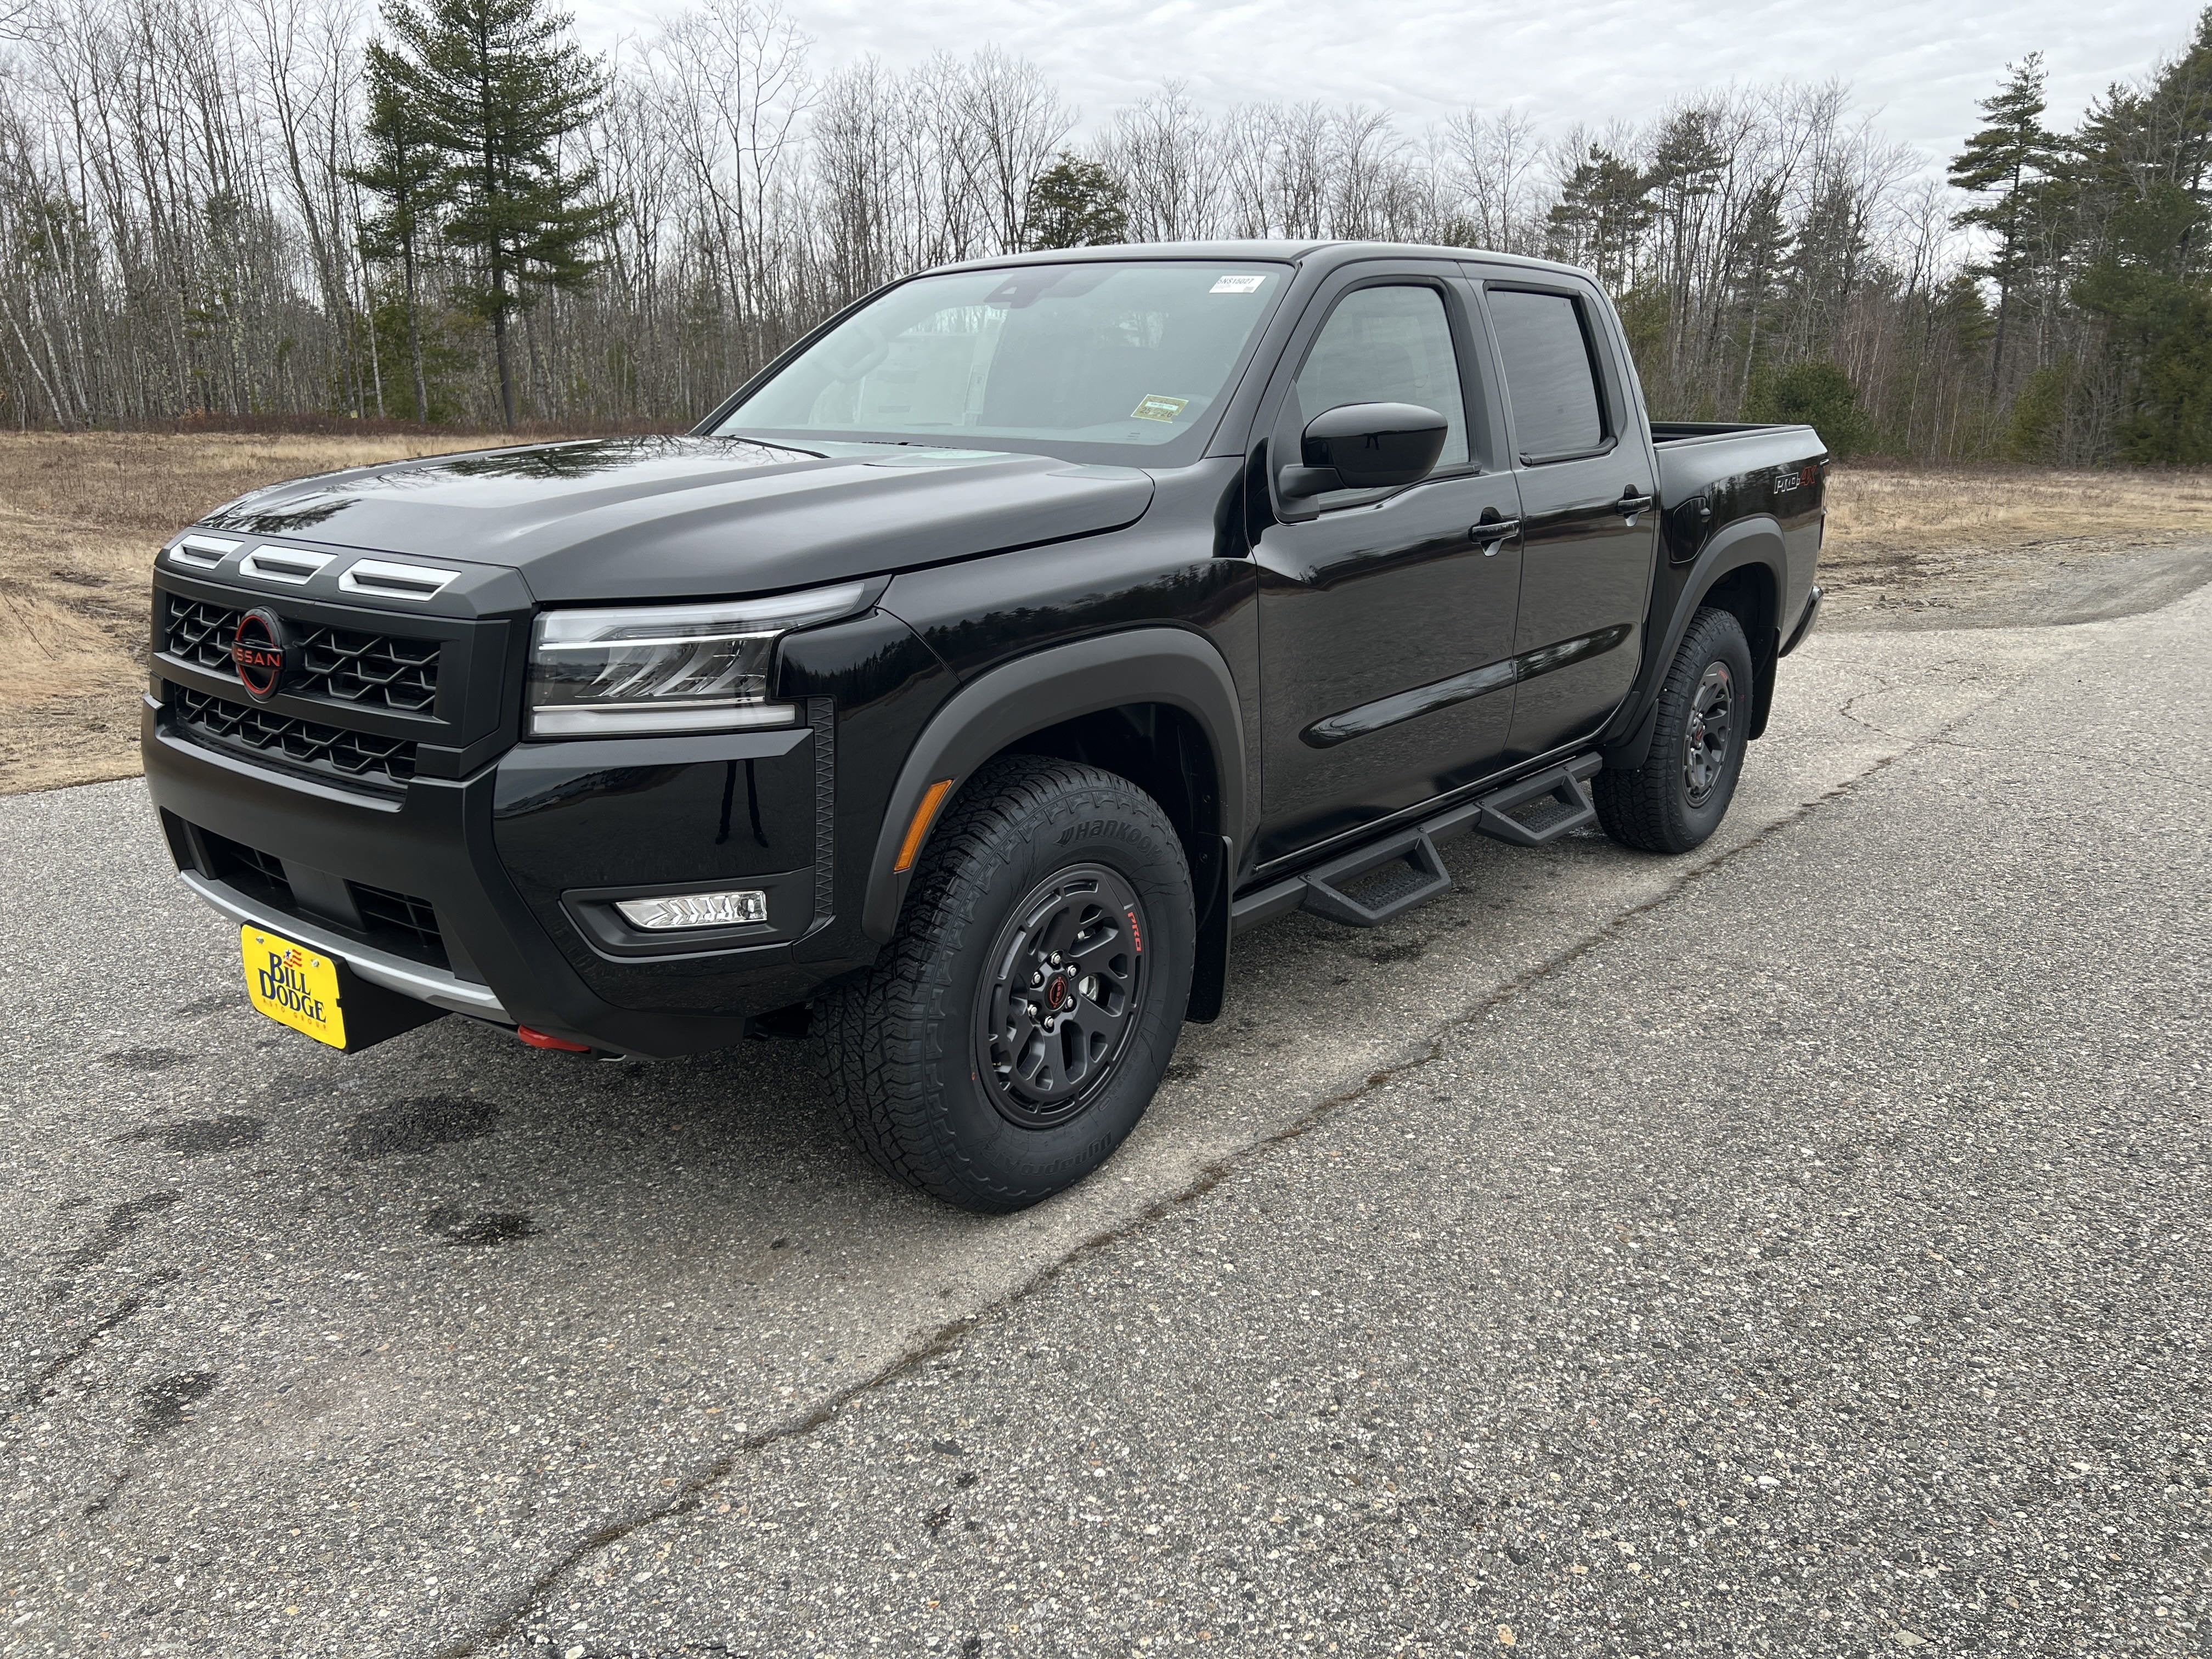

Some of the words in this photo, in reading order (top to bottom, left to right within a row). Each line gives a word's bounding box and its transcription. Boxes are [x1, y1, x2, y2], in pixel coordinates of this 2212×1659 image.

[232, 644, 282, 668] SSAN
[1127, 912, 1142, 951] PRO
[268, 951, 312, 996] BILL
[258, 968, 326, 1023] DODGE
